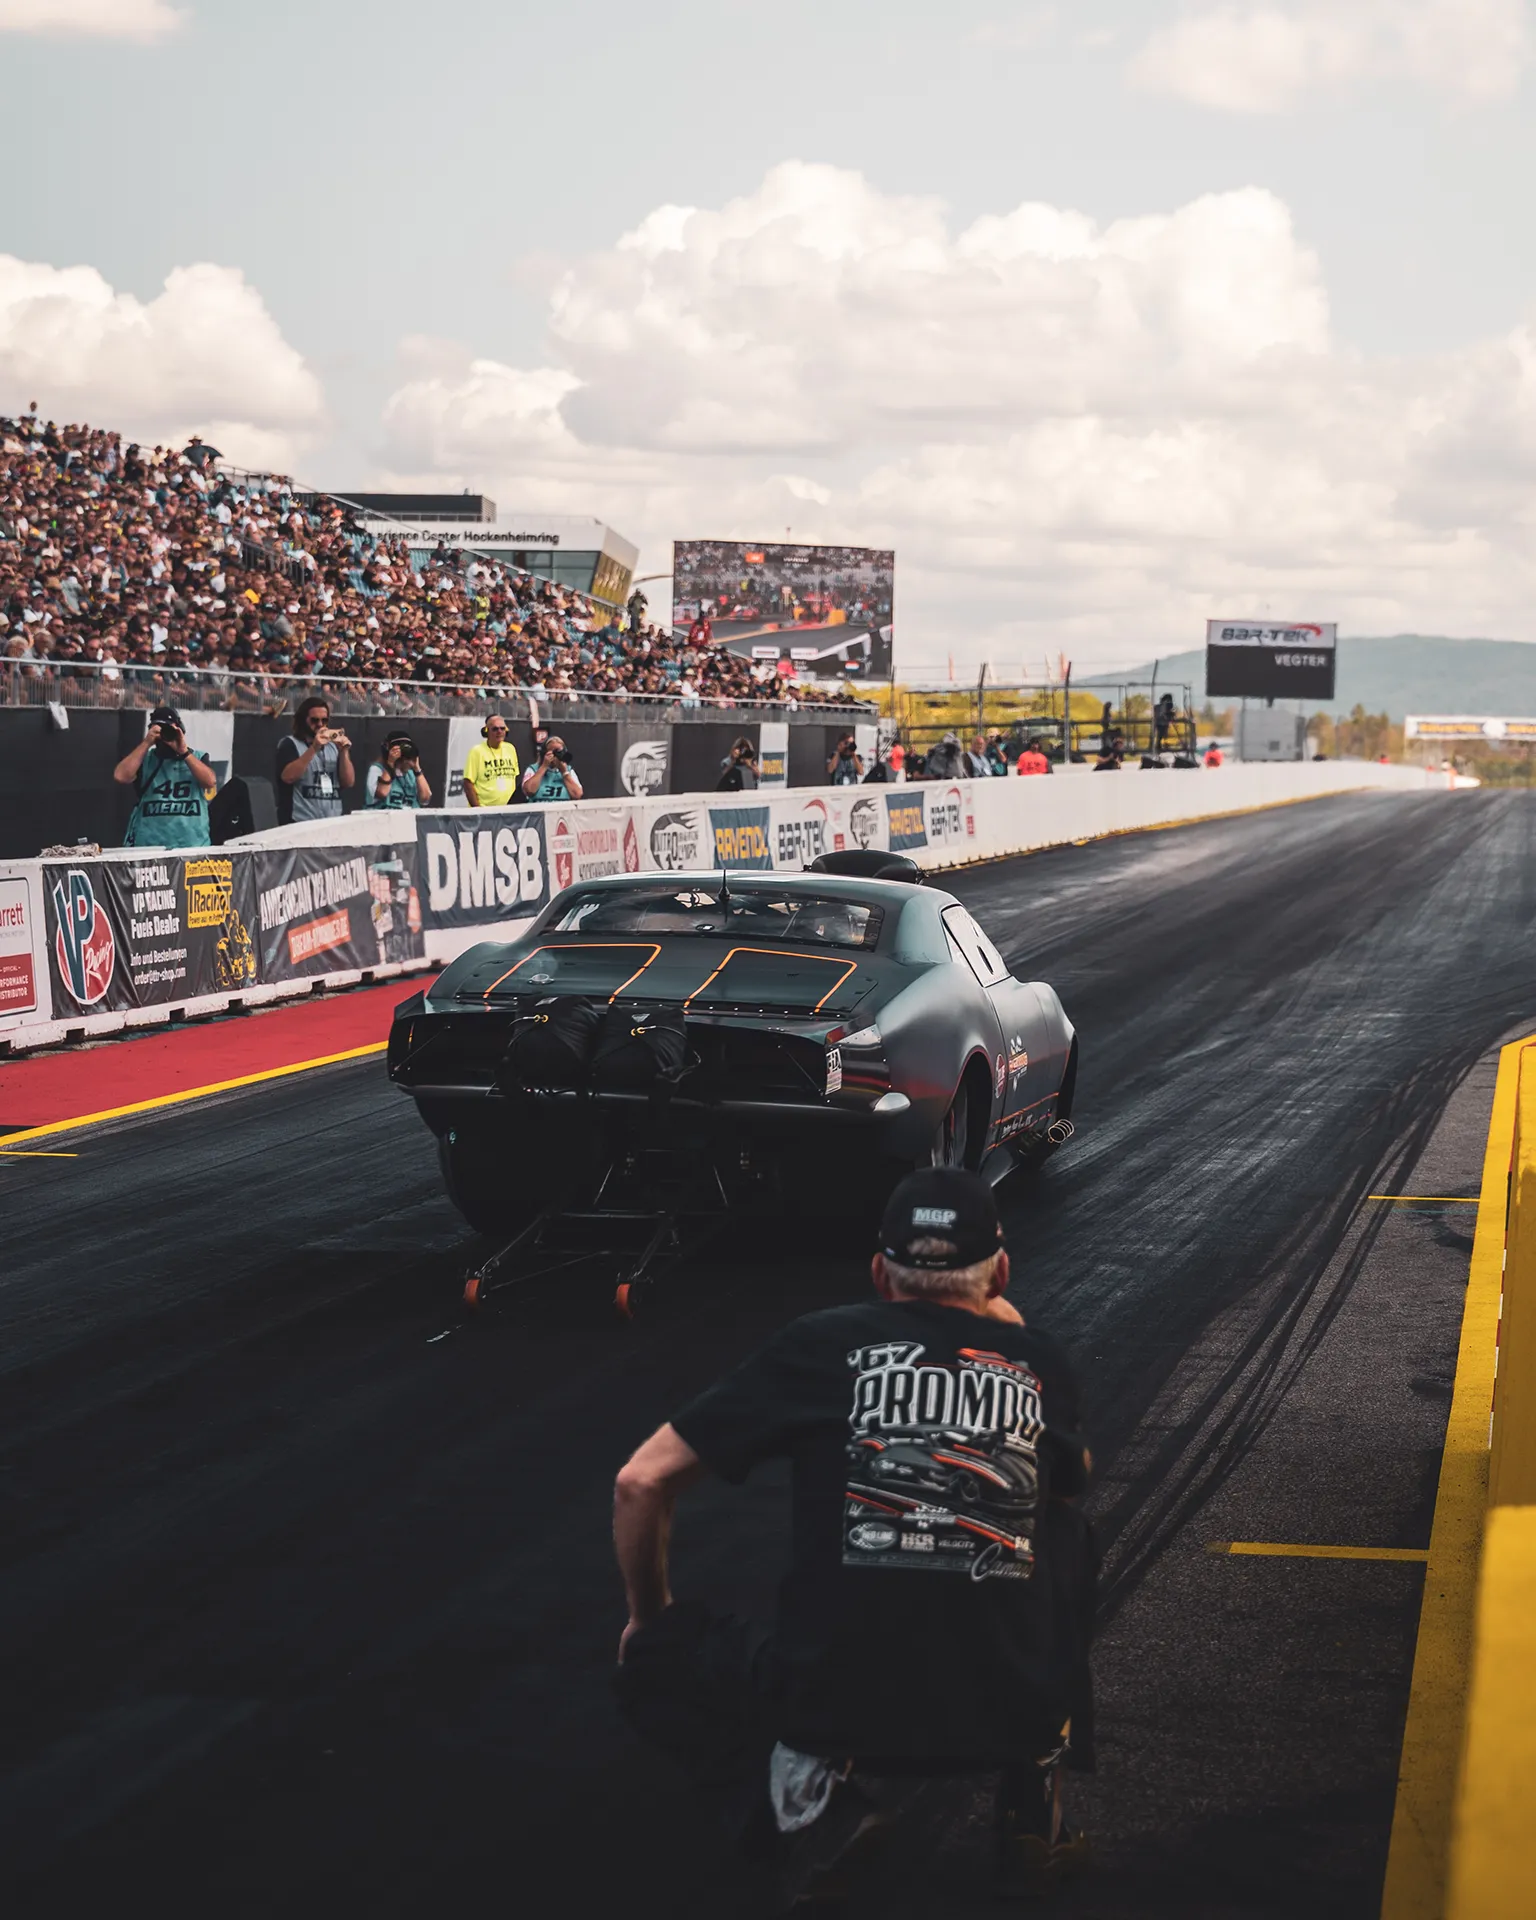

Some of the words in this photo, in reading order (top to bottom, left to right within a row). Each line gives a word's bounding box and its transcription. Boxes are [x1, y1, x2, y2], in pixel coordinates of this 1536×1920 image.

[422, 529, 461, 542] Center
[464, 531, 560, 545] Hockenheimring
[1275, 653, 1326, 667] VEGTER
[153, 780, 192, 799] 46
[542, 785, 563, 797] 31
[147, 802, 199, 815] MEDIA
[715, 825, 769, 861] RAVENOL
[135, 865, 170, 888] OFFICIAL
[426, 827, 544, 911] DMSB
[132, 893, 145, 914] VP
[145, 889, 177, 912] RACING
[260, 876, 312, 931] AMERICAN
[325, 856, 369, 905] MAGAZIN
[0, 903, 25, 927] arrett
[131, 918, 154, 939] Fuels
[153, 914, 180, 936] Dealer
[53, 869, 95, 1001] VP
[86, 939, 114, 988] Racing
[130, 953, 141, 966] Info
[142, 950, 153, 965] und
[154, 947, 187, 963] Bestellungen
[914, 1208, 957, 1224] MGP
[848, 1366, 955, 1434] PRO
[956, 1369, 1046, 1449] MOD
